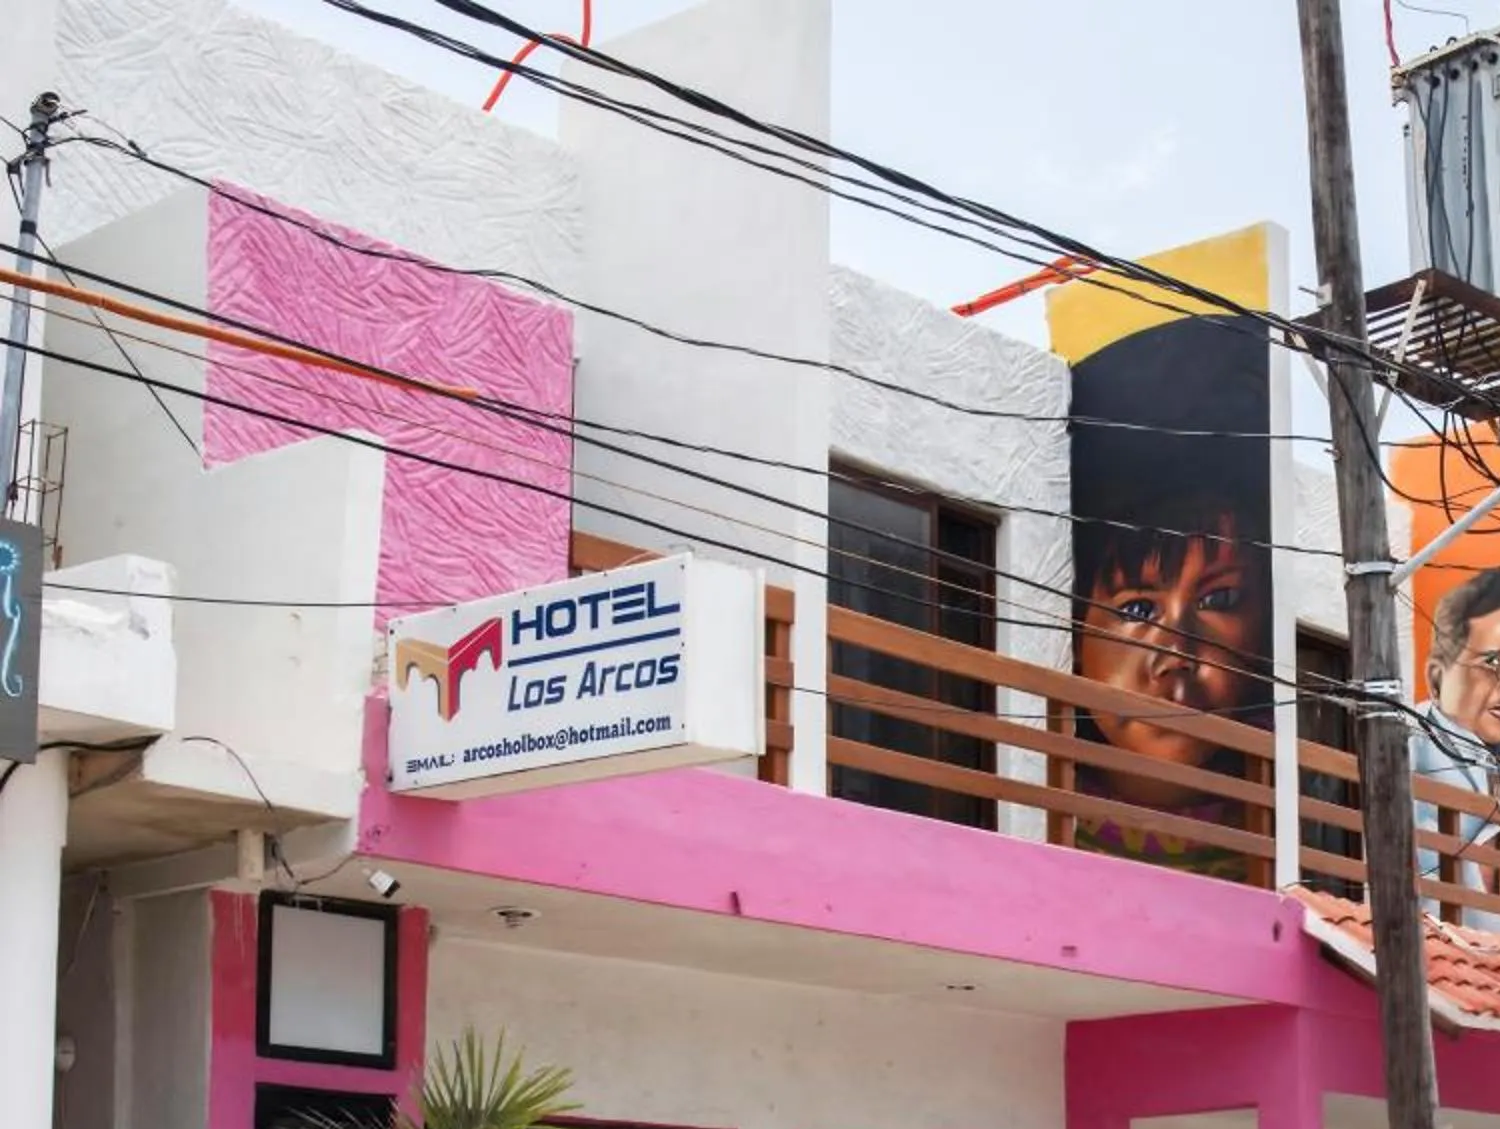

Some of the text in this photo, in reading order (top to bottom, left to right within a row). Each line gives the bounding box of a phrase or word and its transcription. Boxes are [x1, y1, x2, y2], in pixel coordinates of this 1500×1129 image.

[511, 581, 681, 646] HOTEL
[507, 653, 681, 712] Los Arcos
[463, 714, 671, 763] arcosholbox@hotmail.com
